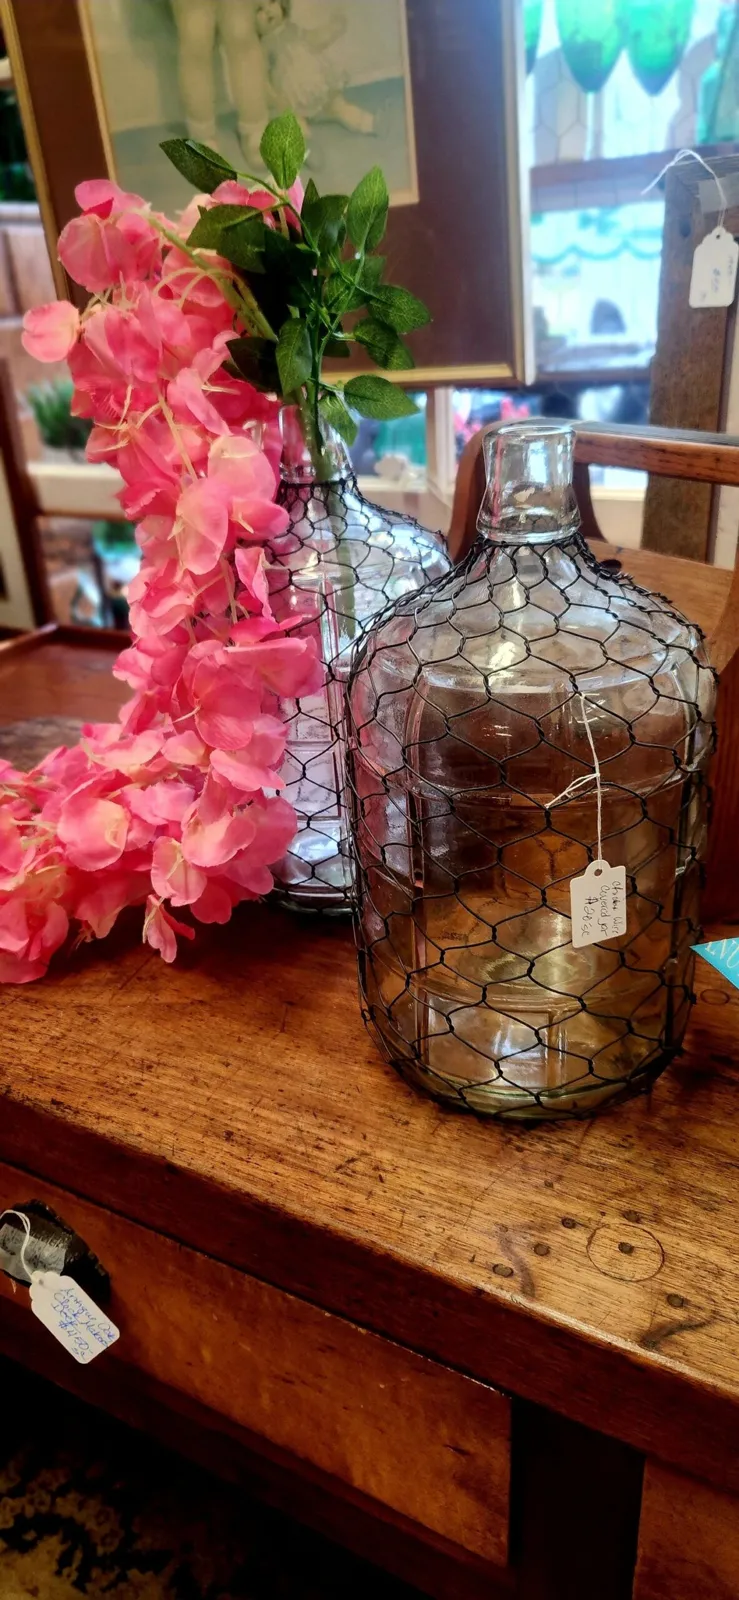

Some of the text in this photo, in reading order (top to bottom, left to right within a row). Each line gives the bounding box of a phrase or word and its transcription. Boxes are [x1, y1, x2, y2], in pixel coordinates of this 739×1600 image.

[599, 885, 611, 917] Covered
[54, 1292, 78, 1318] Clock
[60, 1288, 96, 1321] Antique
